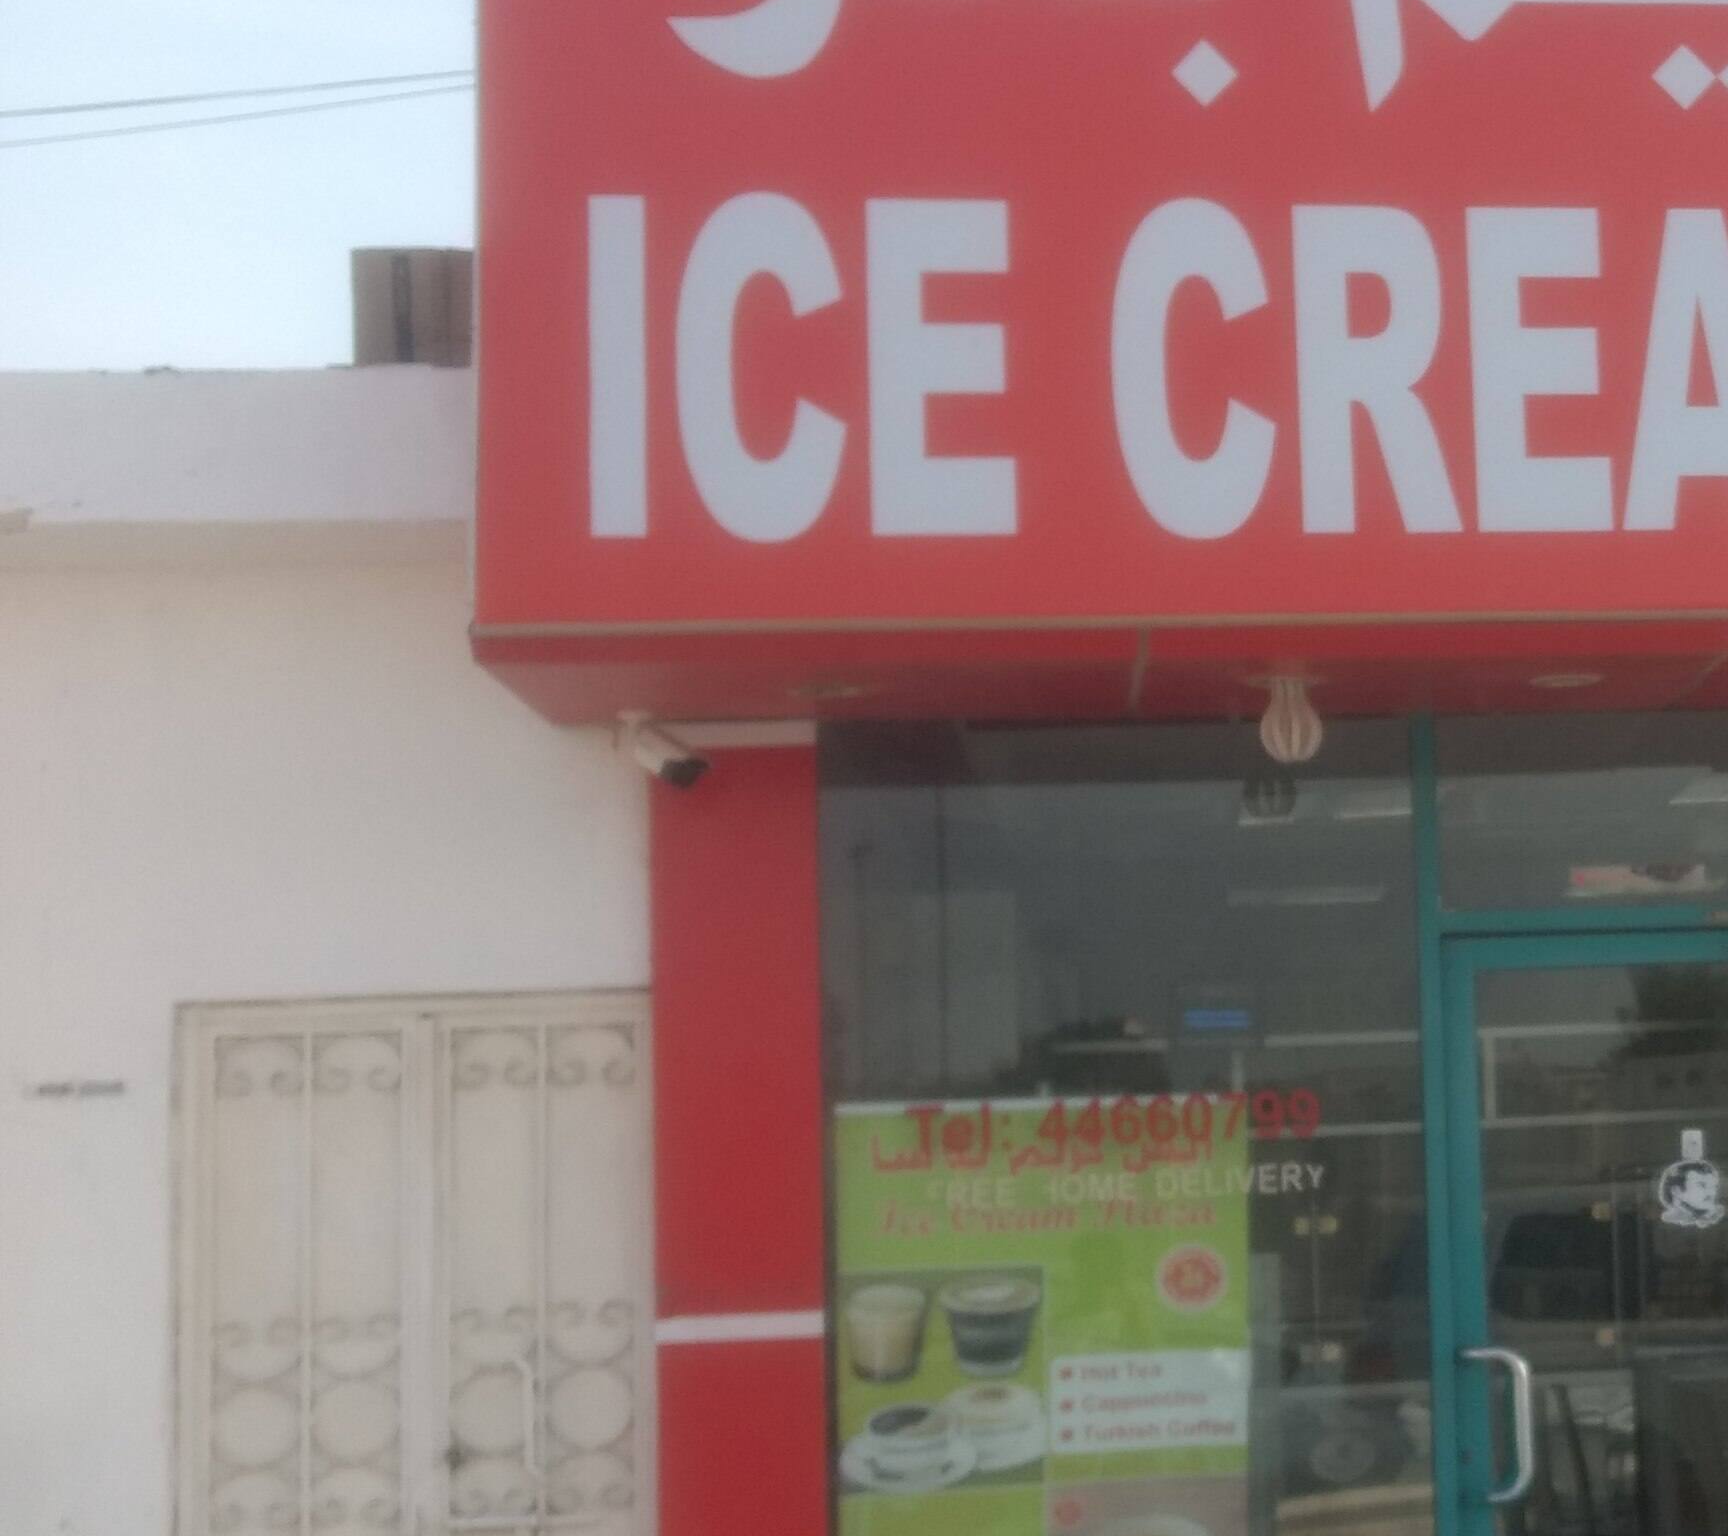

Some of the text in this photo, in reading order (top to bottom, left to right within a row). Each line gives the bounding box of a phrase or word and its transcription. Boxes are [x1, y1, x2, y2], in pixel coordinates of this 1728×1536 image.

[585, 190, 1020, 545] ICE
[1037, 1087, 1322, 1141] 44660799
[1156, 1163, 1325, 1198] DELIVERY
